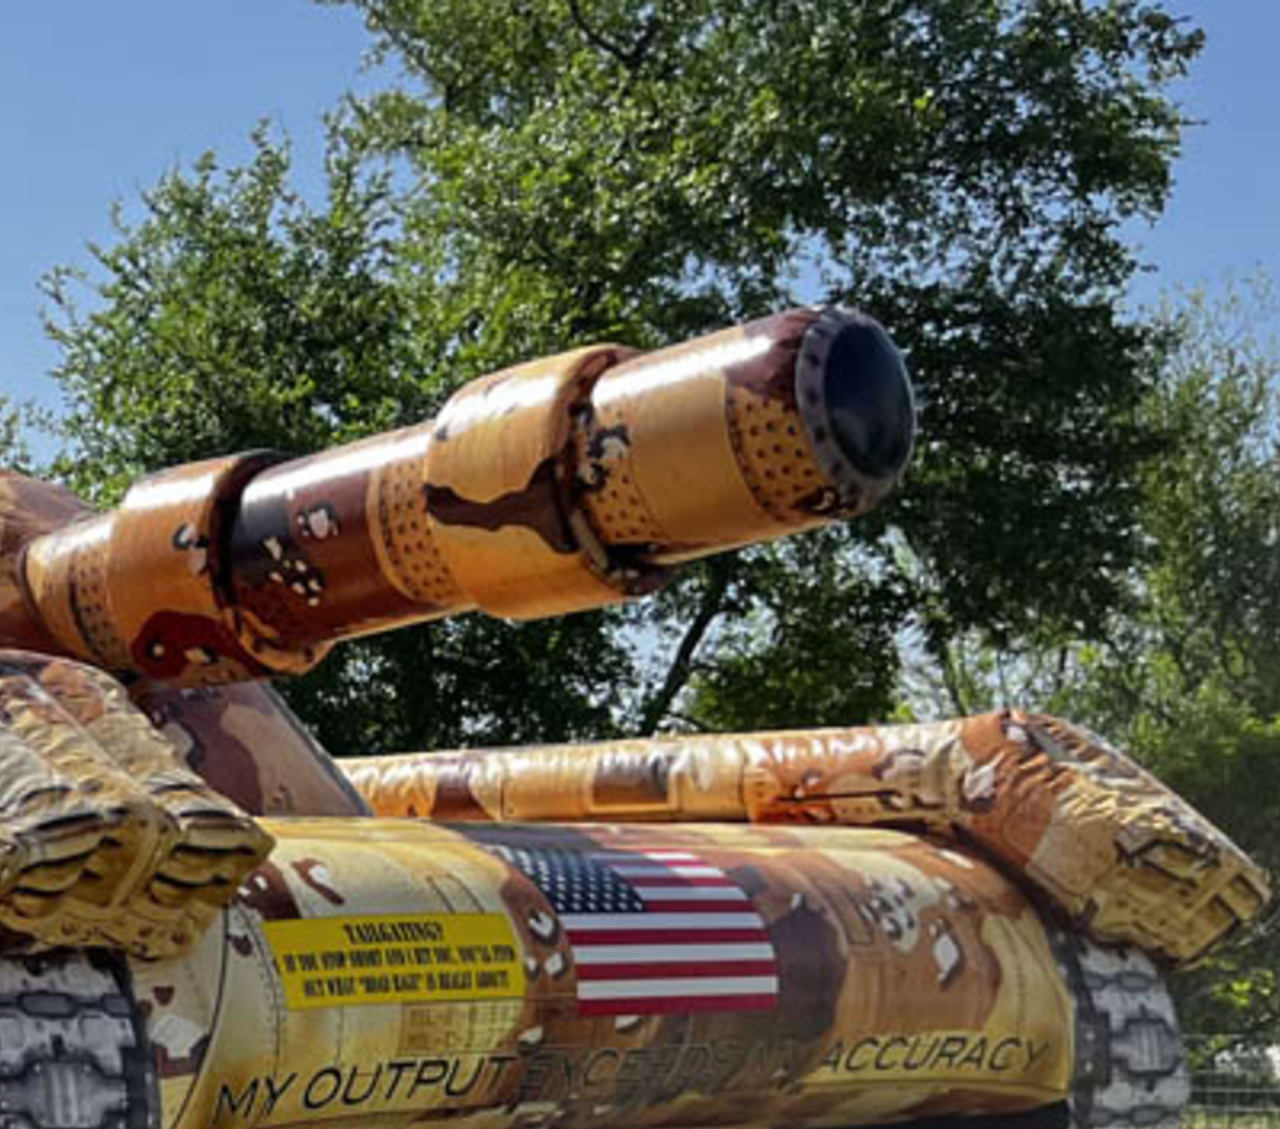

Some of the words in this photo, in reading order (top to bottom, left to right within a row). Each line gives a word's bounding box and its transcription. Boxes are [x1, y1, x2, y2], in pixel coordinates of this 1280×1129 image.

[327, 976, 356, 996] WHAT
[212, 1072, 296, 1125] MY
[302, 1056, 517, 1109] OUTPUT
[821, 1036, 1050, 1072] ACCURACY
